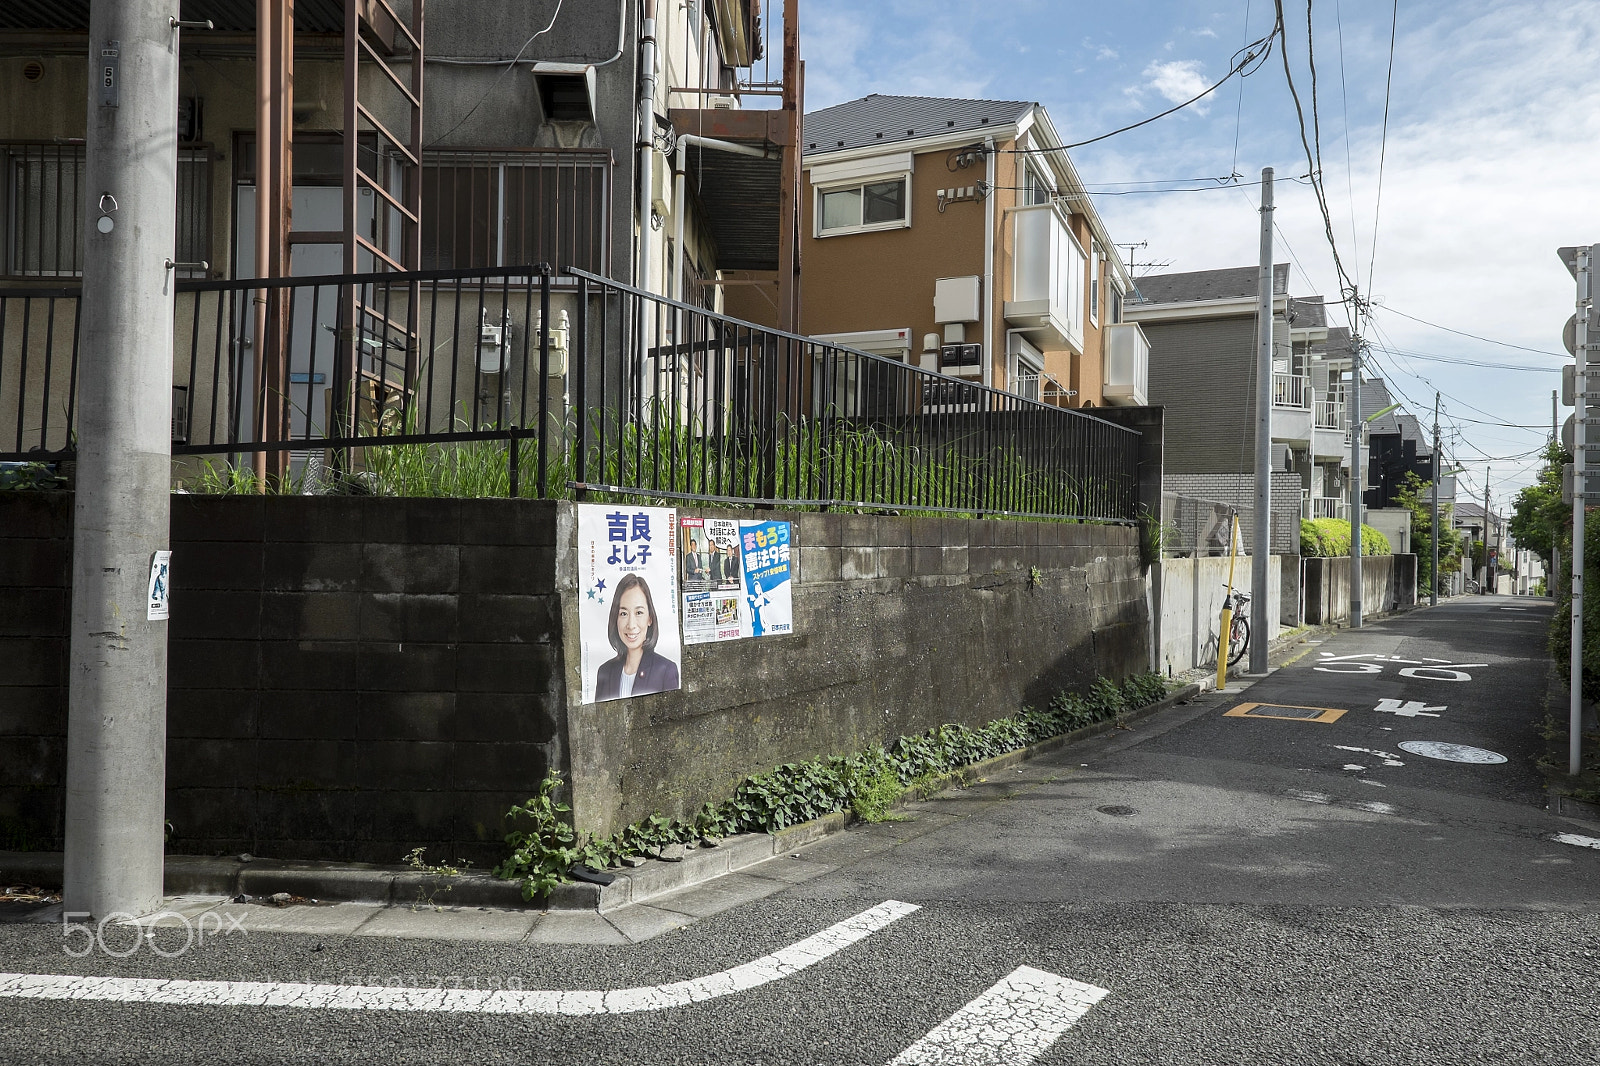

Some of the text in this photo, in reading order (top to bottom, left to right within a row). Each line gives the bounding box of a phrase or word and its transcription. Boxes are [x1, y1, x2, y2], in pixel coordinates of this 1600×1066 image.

[606, 511, 652, 542] 吉良
[709, 527, 737, 536] 対話による
[743, 524, 788, 552] まもろう
[607, 544, 652, 565] よし子
[1313, 662, 1473, 682] 30
